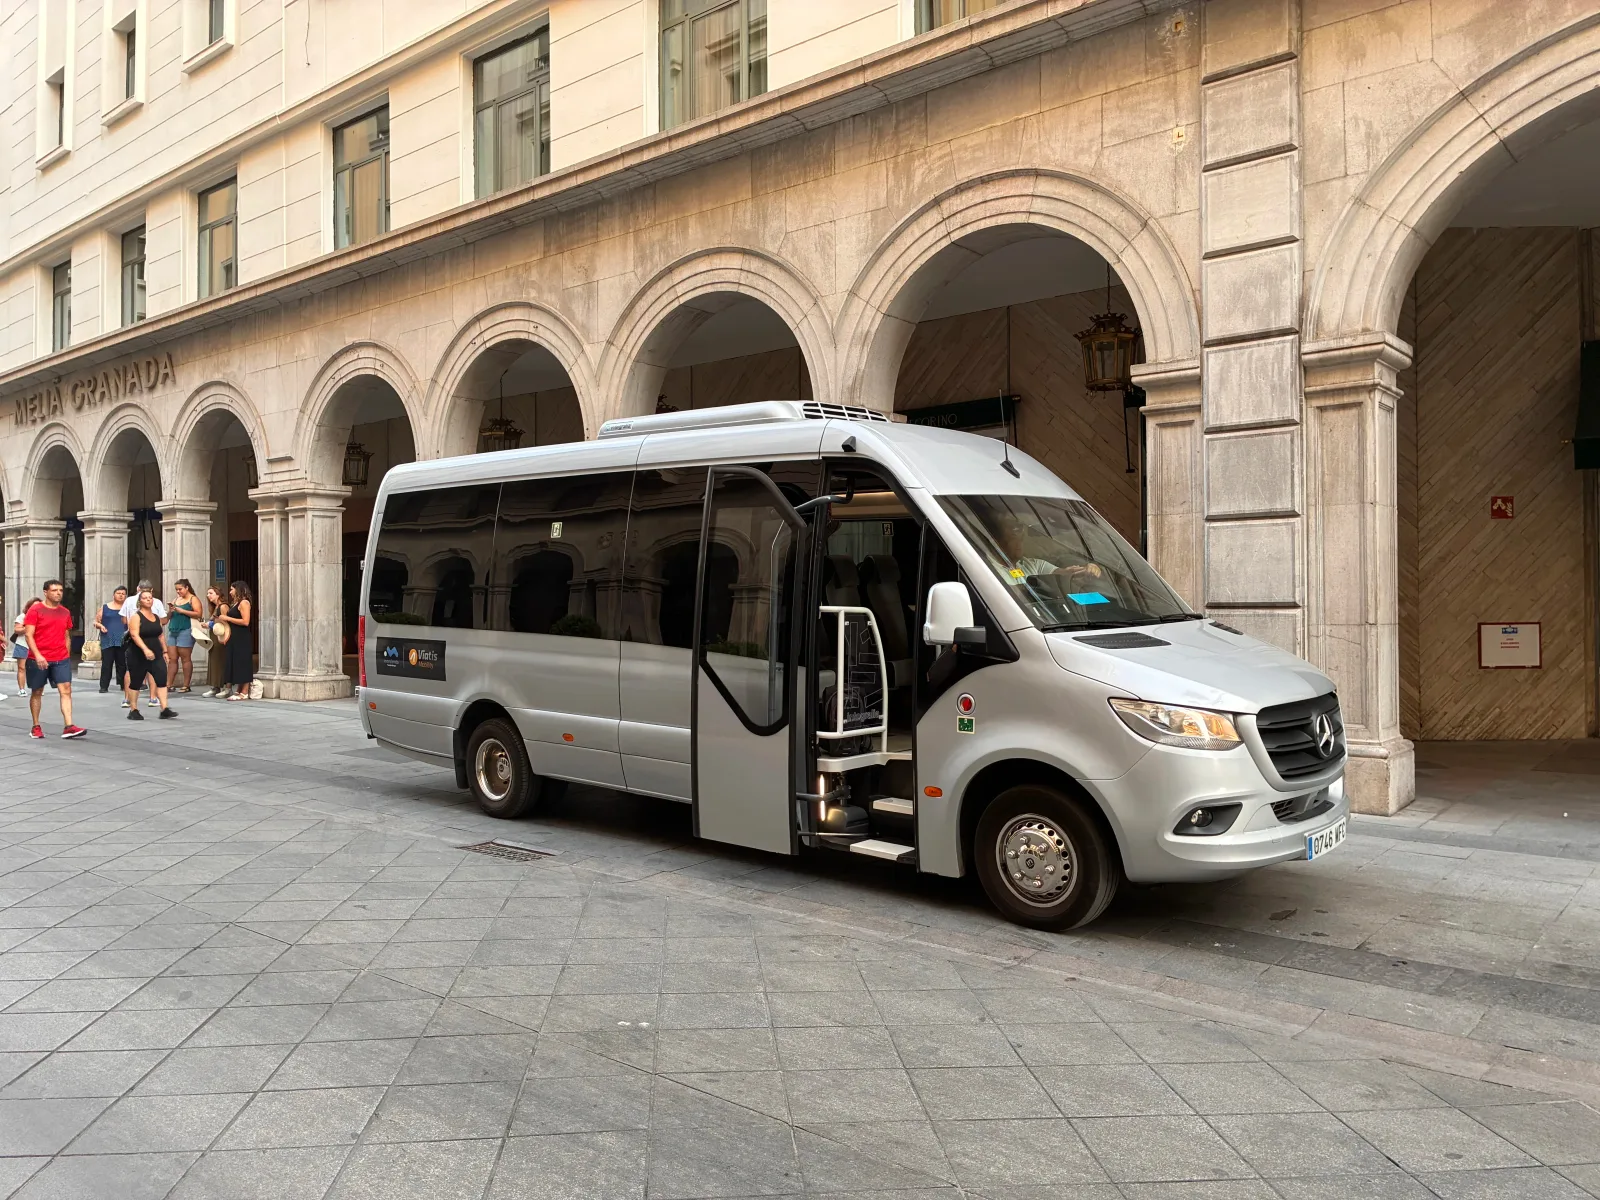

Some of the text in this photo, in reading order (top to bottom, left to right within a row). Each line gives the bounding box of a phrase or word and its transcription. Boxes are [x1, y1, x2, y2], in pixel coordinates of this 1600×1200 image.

[70, 352, 177, 411] GRANADA
[418, 649, 438, 662] Viatis
[1313, 830, 1334, 855] 0746
